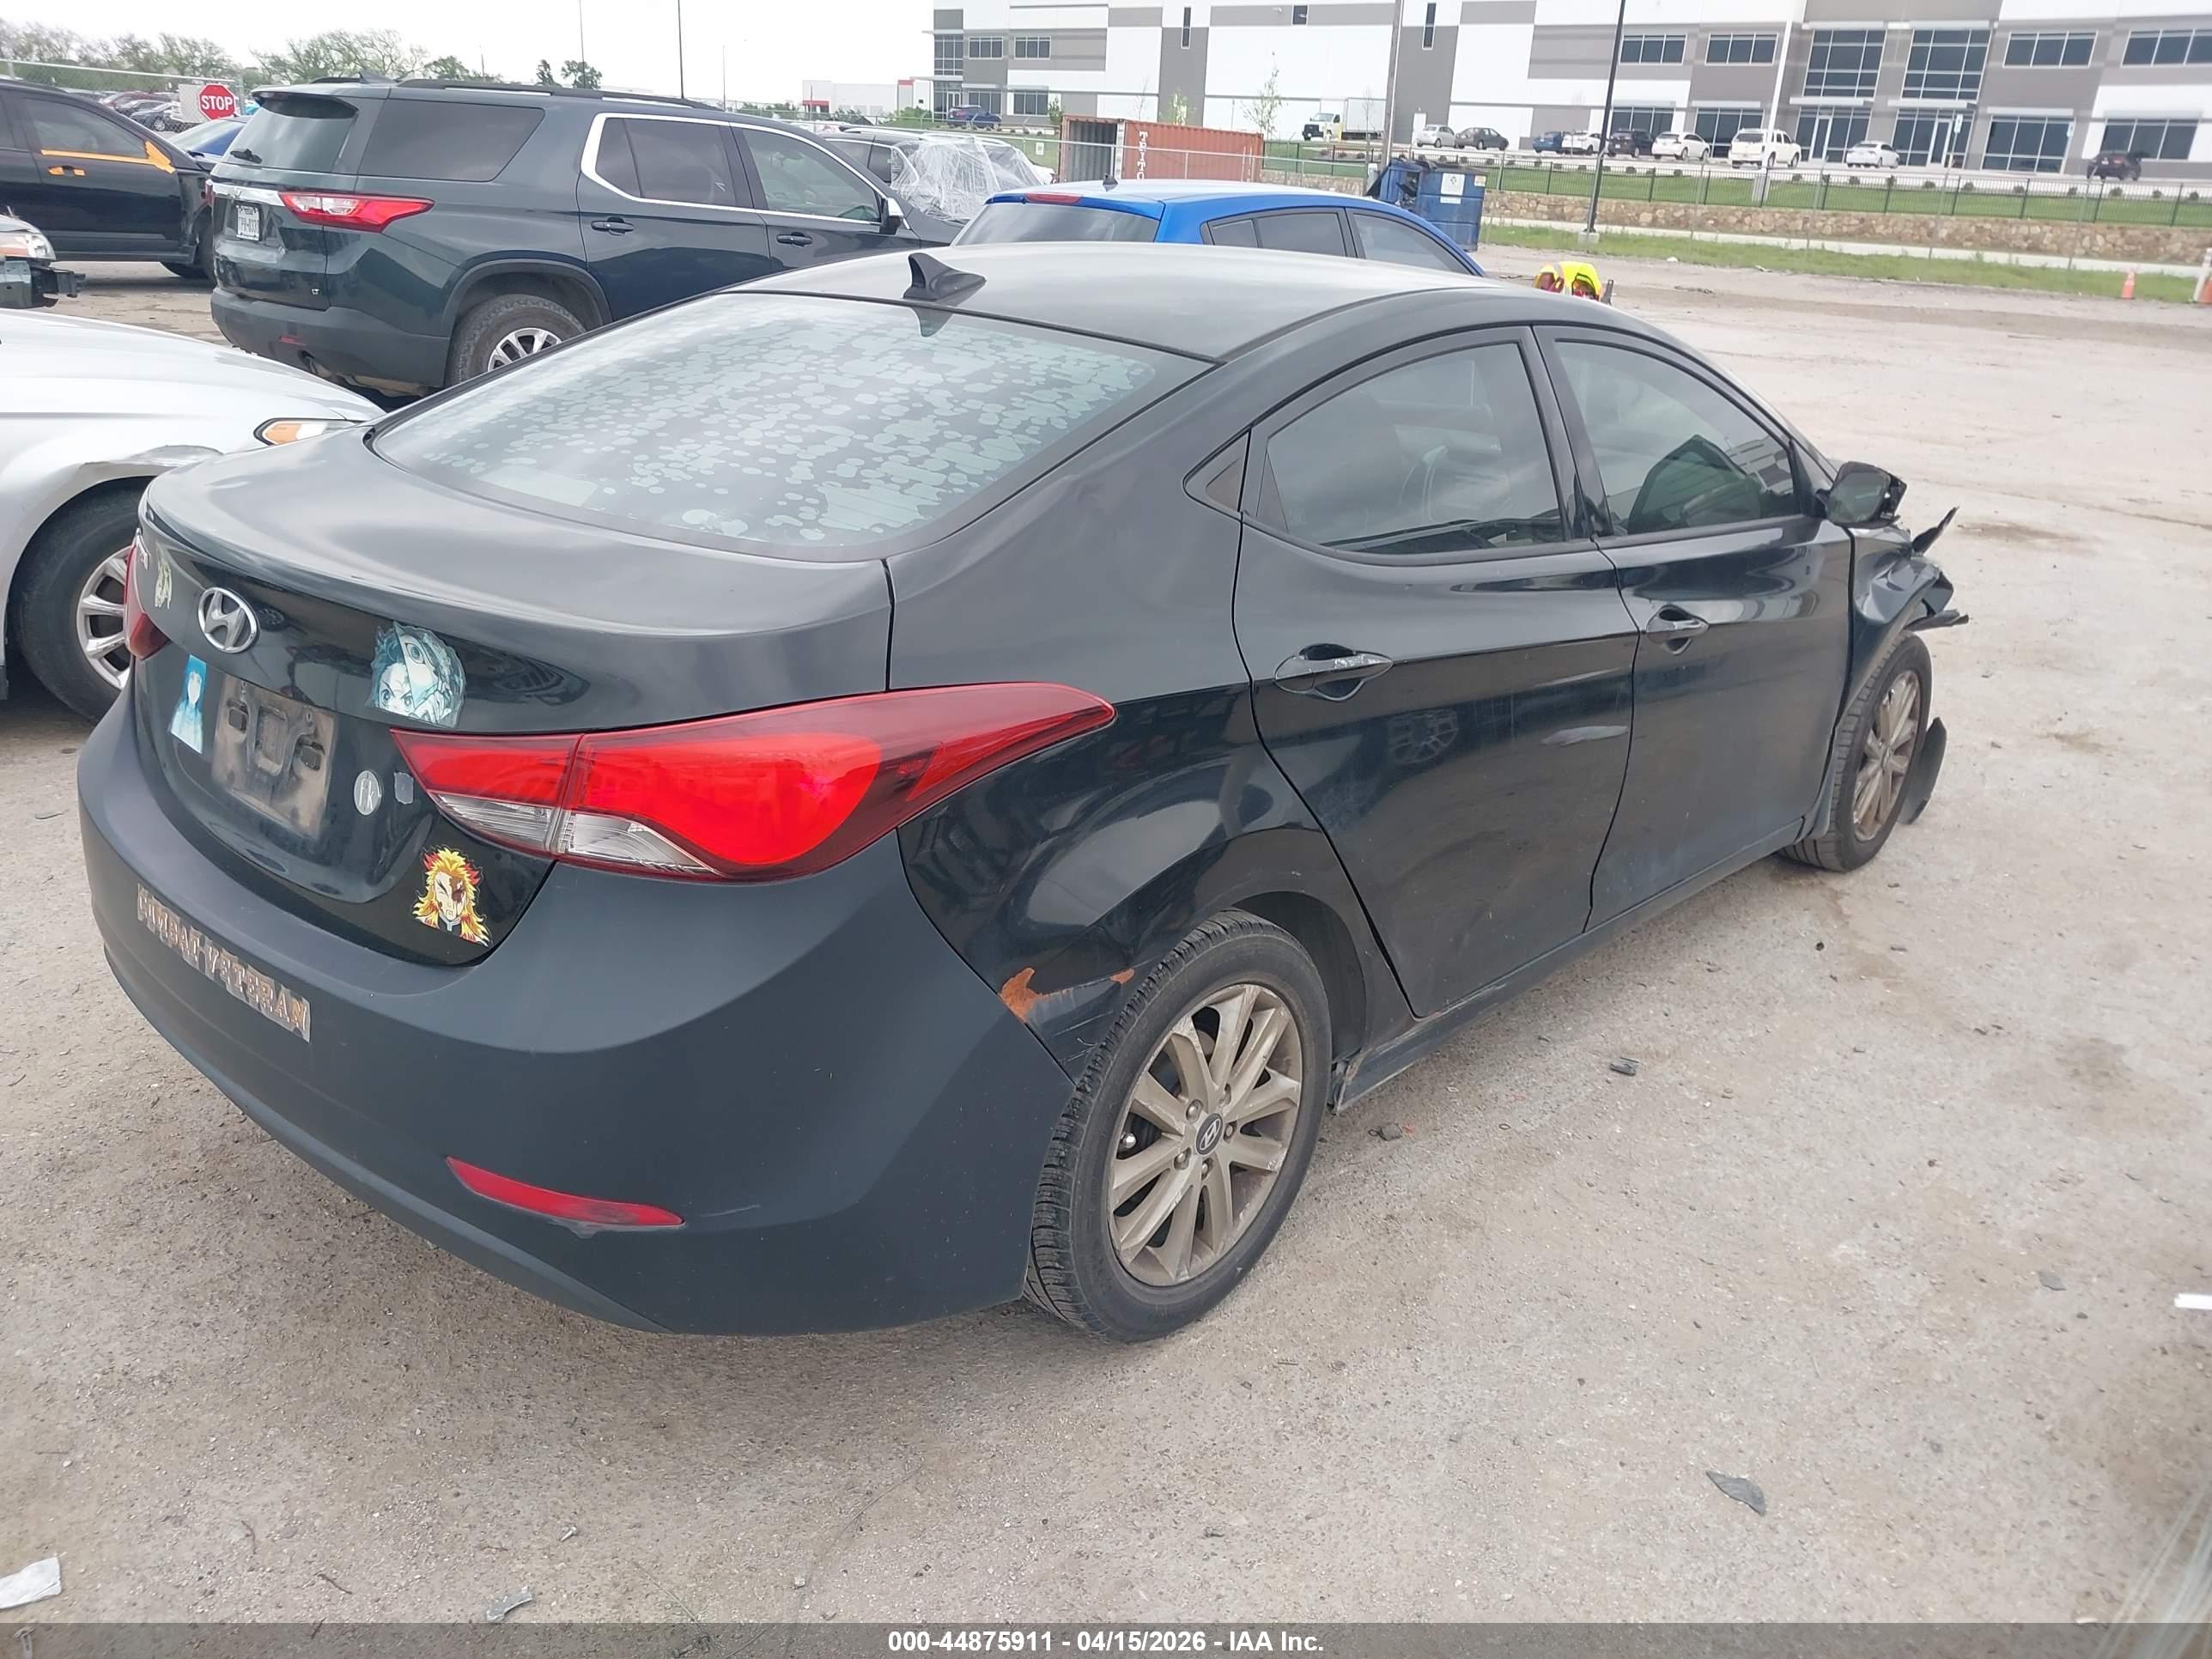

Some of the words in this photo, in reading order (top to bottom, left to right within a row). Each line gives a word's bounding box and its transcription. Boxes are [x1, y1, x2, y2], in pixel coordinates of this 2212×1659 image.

[201, 94, 234, 111] STOP
[137, 887, 203, 963] COMBAT
[207, 944, 308, 1033] VETERAN
